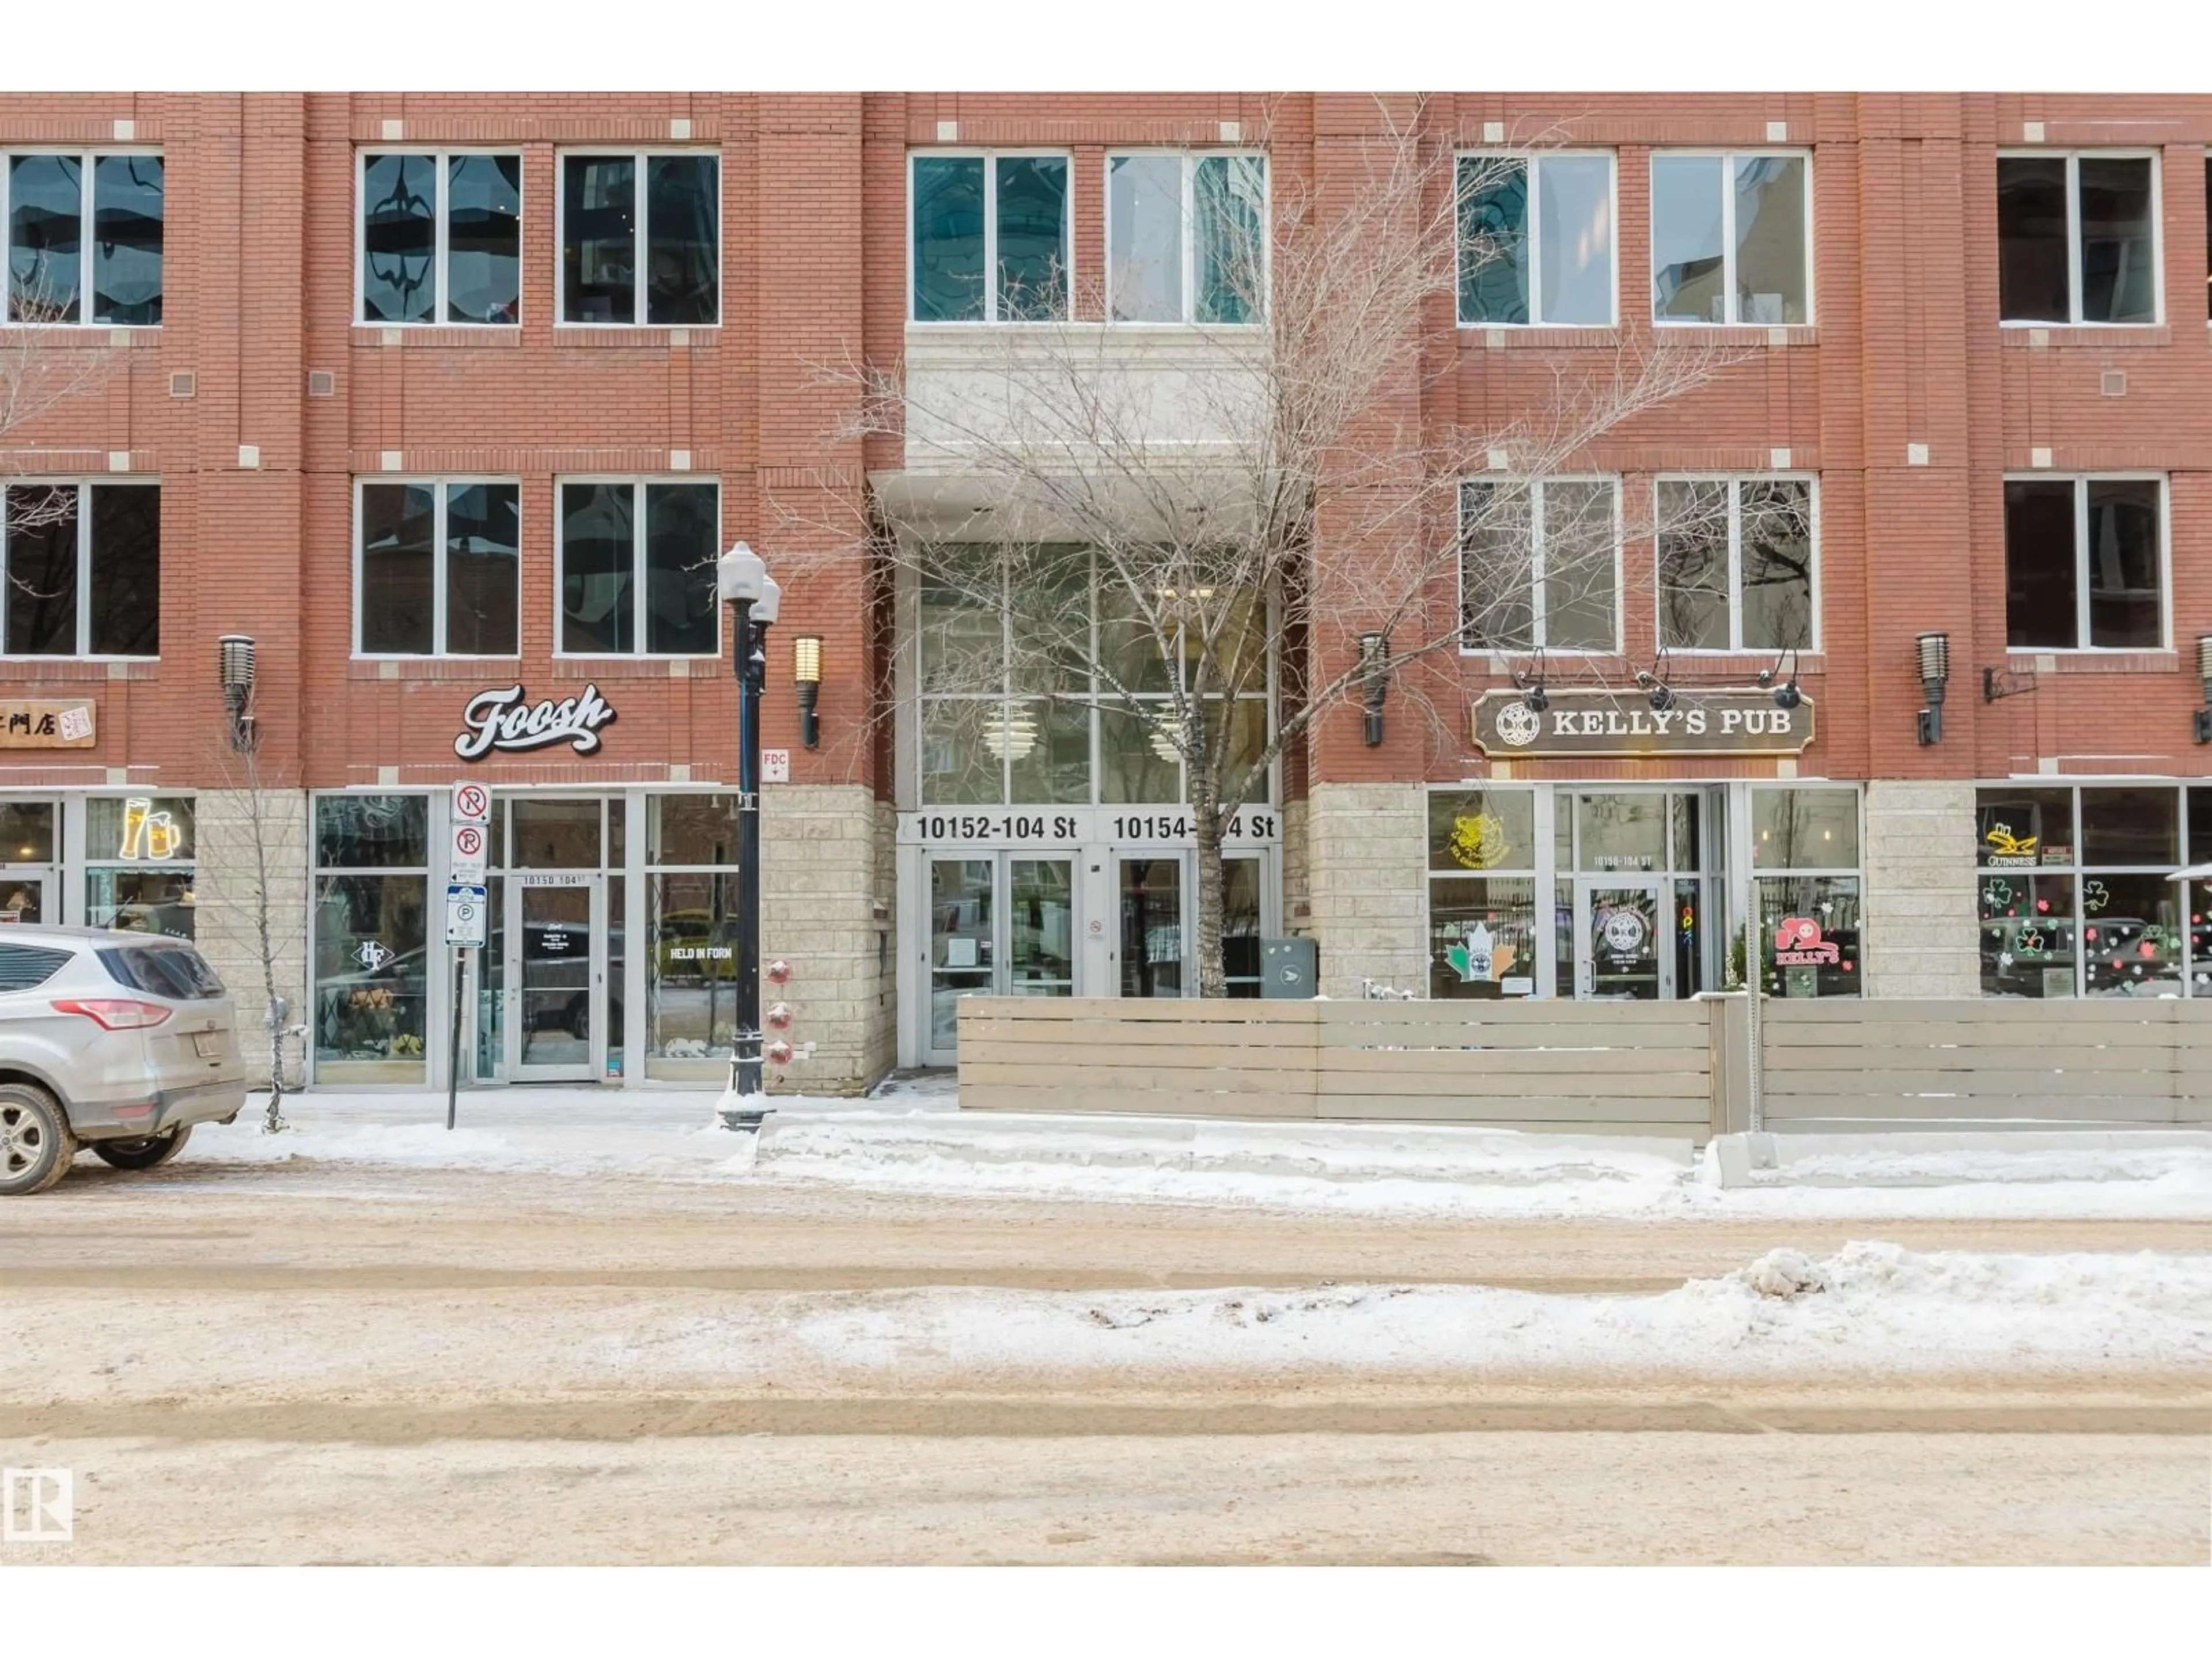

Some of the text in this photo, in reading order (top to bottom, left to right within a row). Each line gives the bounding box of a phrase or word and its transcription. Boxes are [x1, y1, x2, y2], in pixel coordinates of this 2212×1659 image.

[454, 684, 614, 758] Foosh
[1552, 709, 1791, 735] KELLY'S PUB
[764, 753, 786, 765] FDC
[917, 816, 1077, 839] 10152-104 St
[1113, 815, 1275, 839] 10154-4 St
[1641, 855, 1652, 866] ST
[1988, 855, 2037, 866] GUINNESS
[525, 876, 554, 885] 10150
[670, 948, 695, 959] HELD
[696, 948, 705, 959] IN
[1776, 950, 1839, 965] KELLY'S
